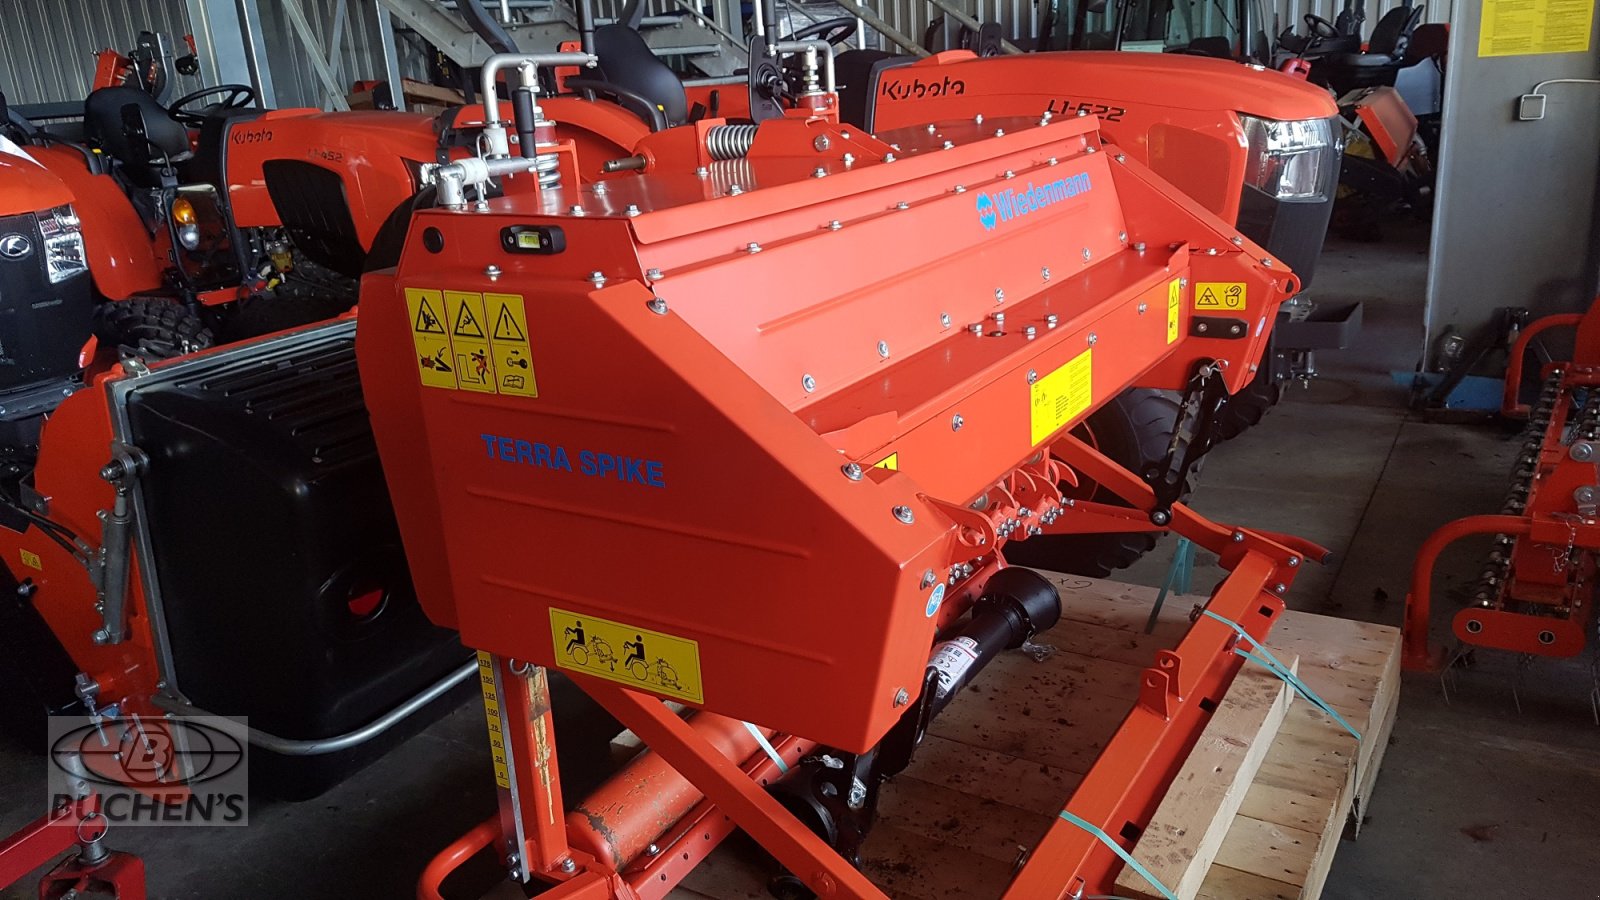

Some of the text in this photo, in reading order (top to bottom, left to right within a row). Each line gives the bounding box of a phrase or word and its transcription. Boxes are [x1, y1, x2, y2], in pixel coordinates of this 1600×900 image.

[882, 76, 966, 101] Kubota
[231, 128, 273, 145] Kubota
[993, 172, 1092, 222] Wiedenmann
[481, 433, 666, 488] TERRA SPIKE
